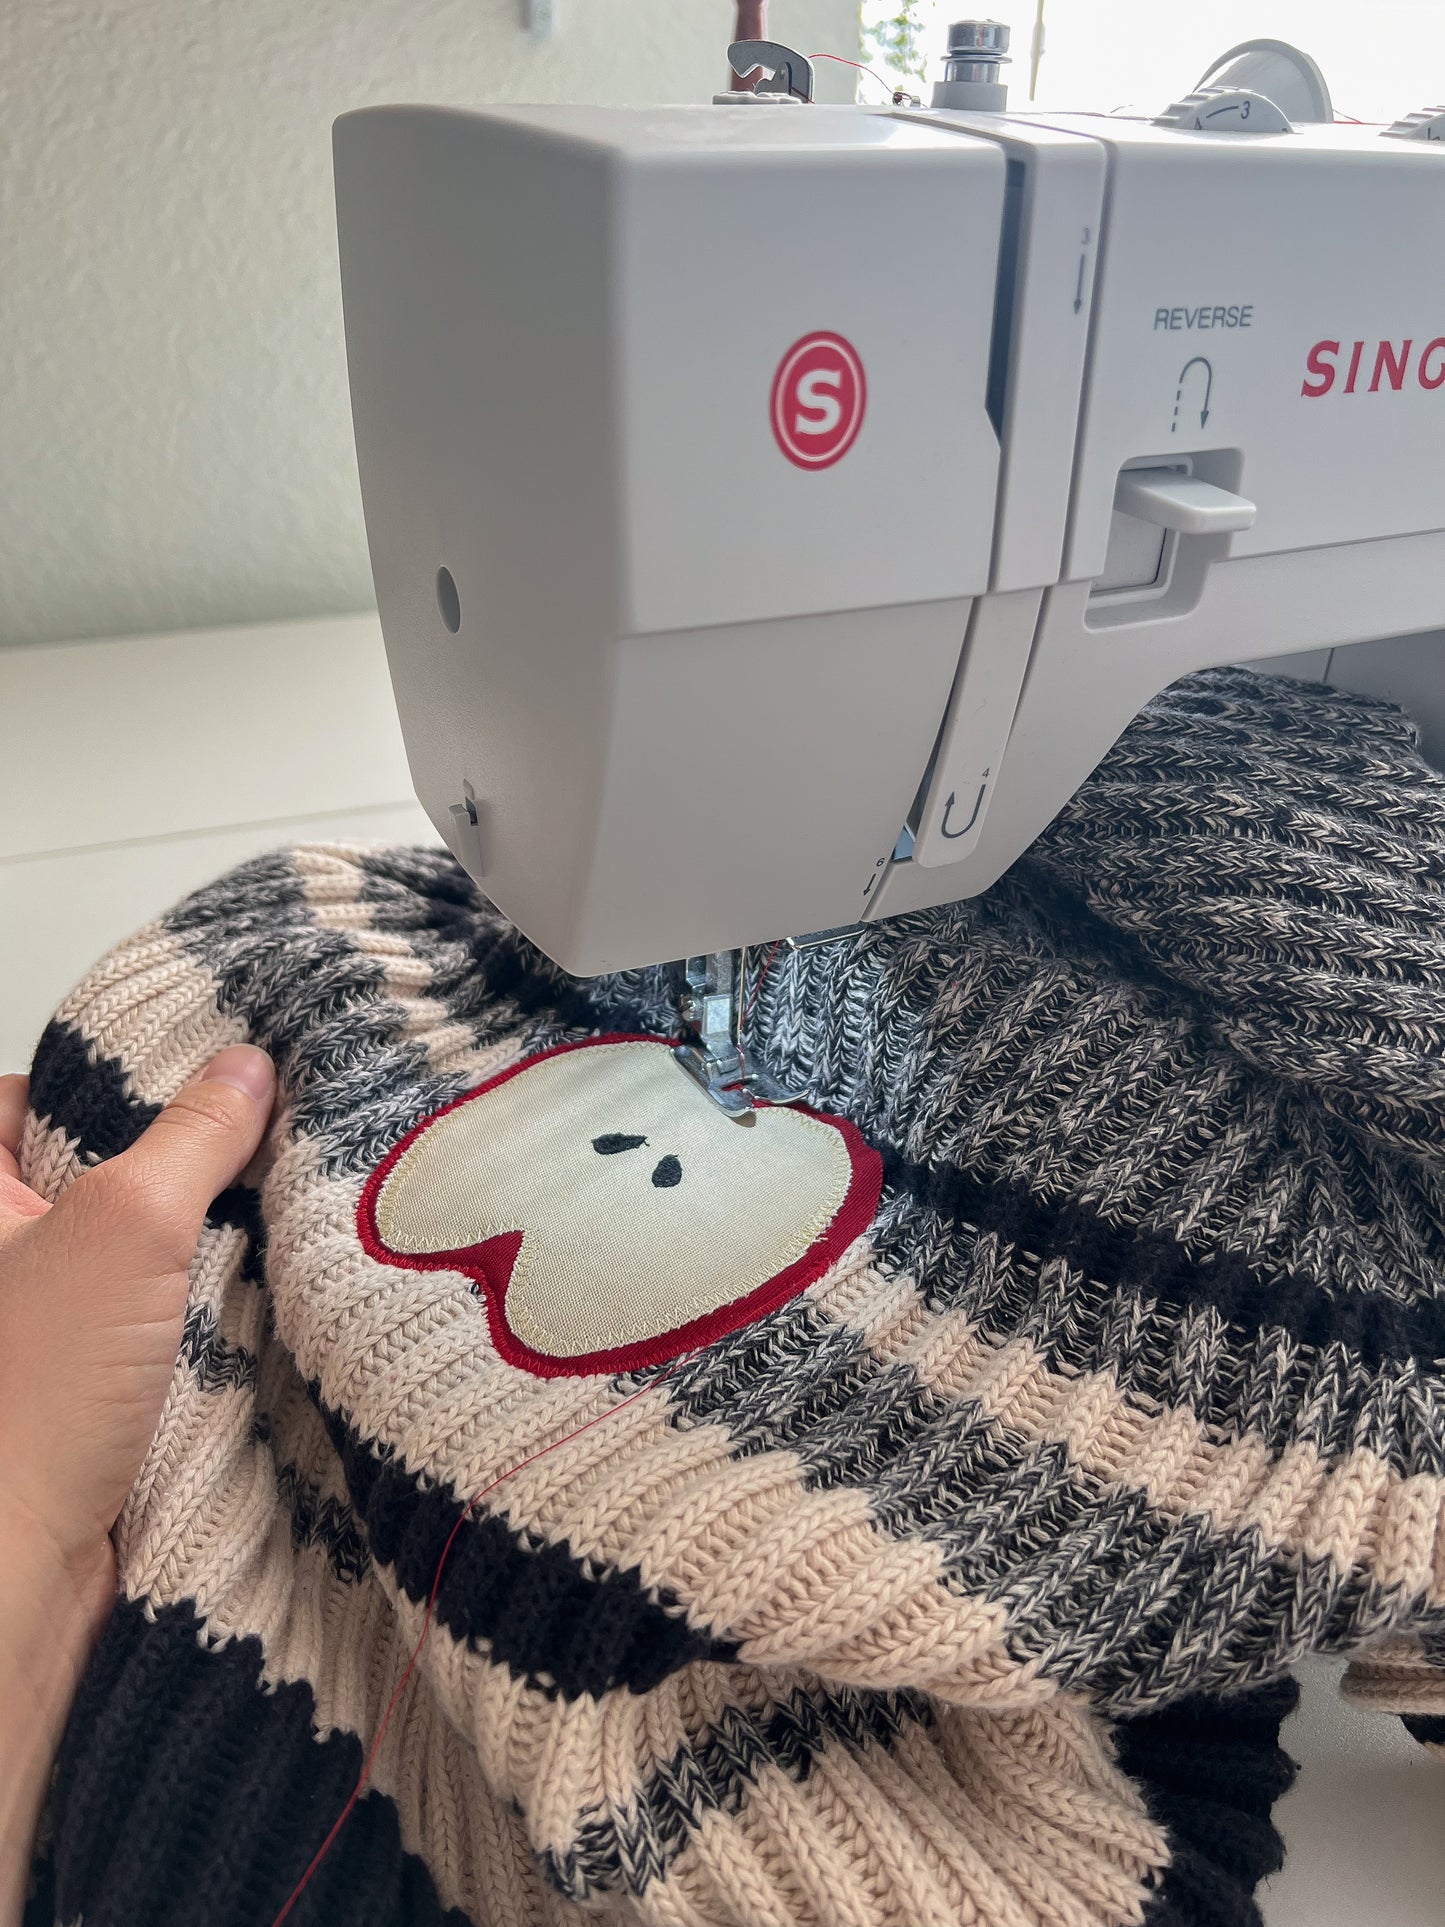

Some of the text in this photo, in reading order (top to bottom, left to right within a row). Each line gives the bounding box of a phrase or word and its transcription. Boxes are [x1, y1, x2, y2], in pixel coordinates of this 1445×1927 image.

[1240, 100, 1251, 120] 3
[1154, 306, 1254, 330] REVERSE
[795, 368, 842, 436] S
[981, 767, 990, 778] 4
[875, 857, 886, 868] 6
